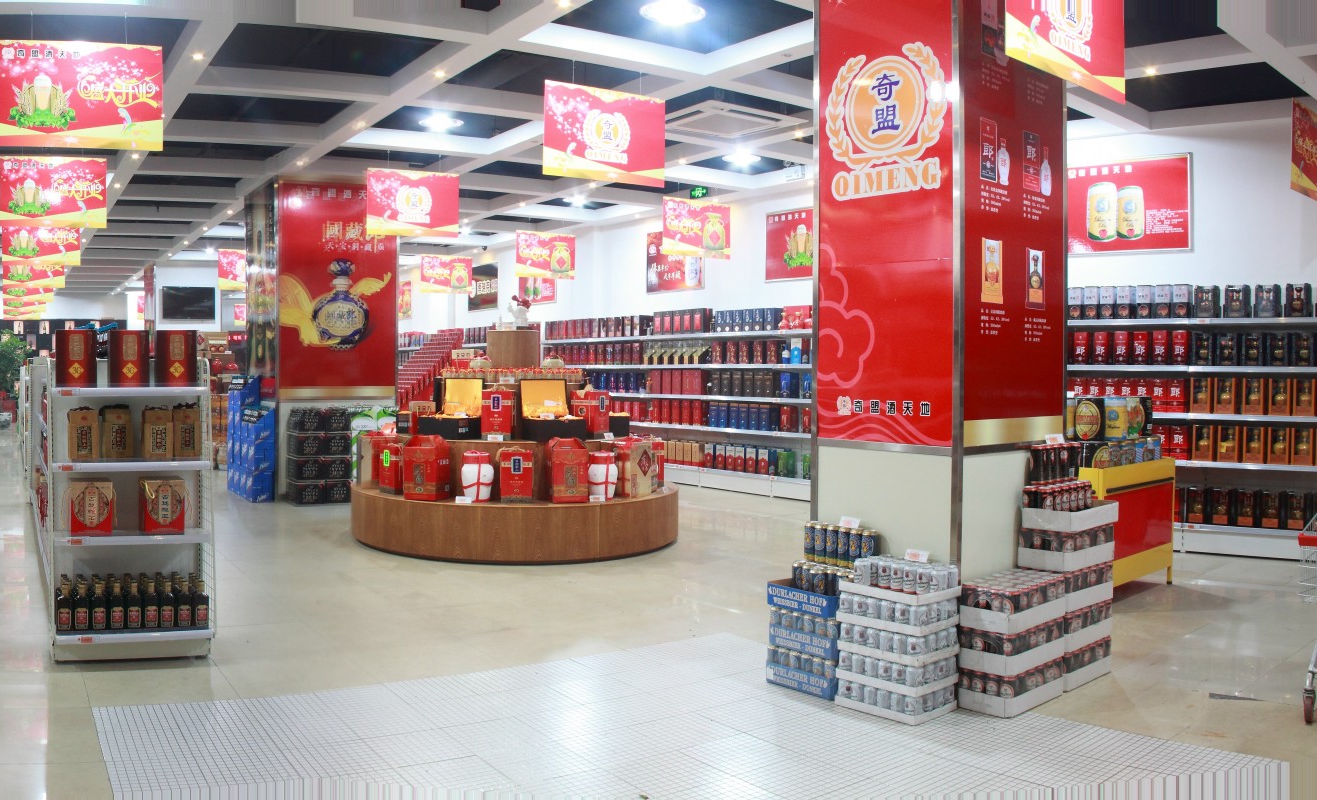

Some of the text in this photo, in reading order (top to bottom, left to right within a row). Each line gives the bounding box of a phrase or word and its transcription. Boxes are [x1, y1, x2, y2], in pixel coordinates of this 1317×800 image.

[17, 48, 81, 59] 奇盟酒天地
[77, 75, 159, 108] 盛大开业
[871, 73, 901, 135] 奇盟
[834, 160, 940, 198] QIMENG
[853, 399, 931, 416] 奇盟酒天地
[771, 586, 824, 606] DURLACHER HOF
[774, 627, 812, 644] DURLACHER
